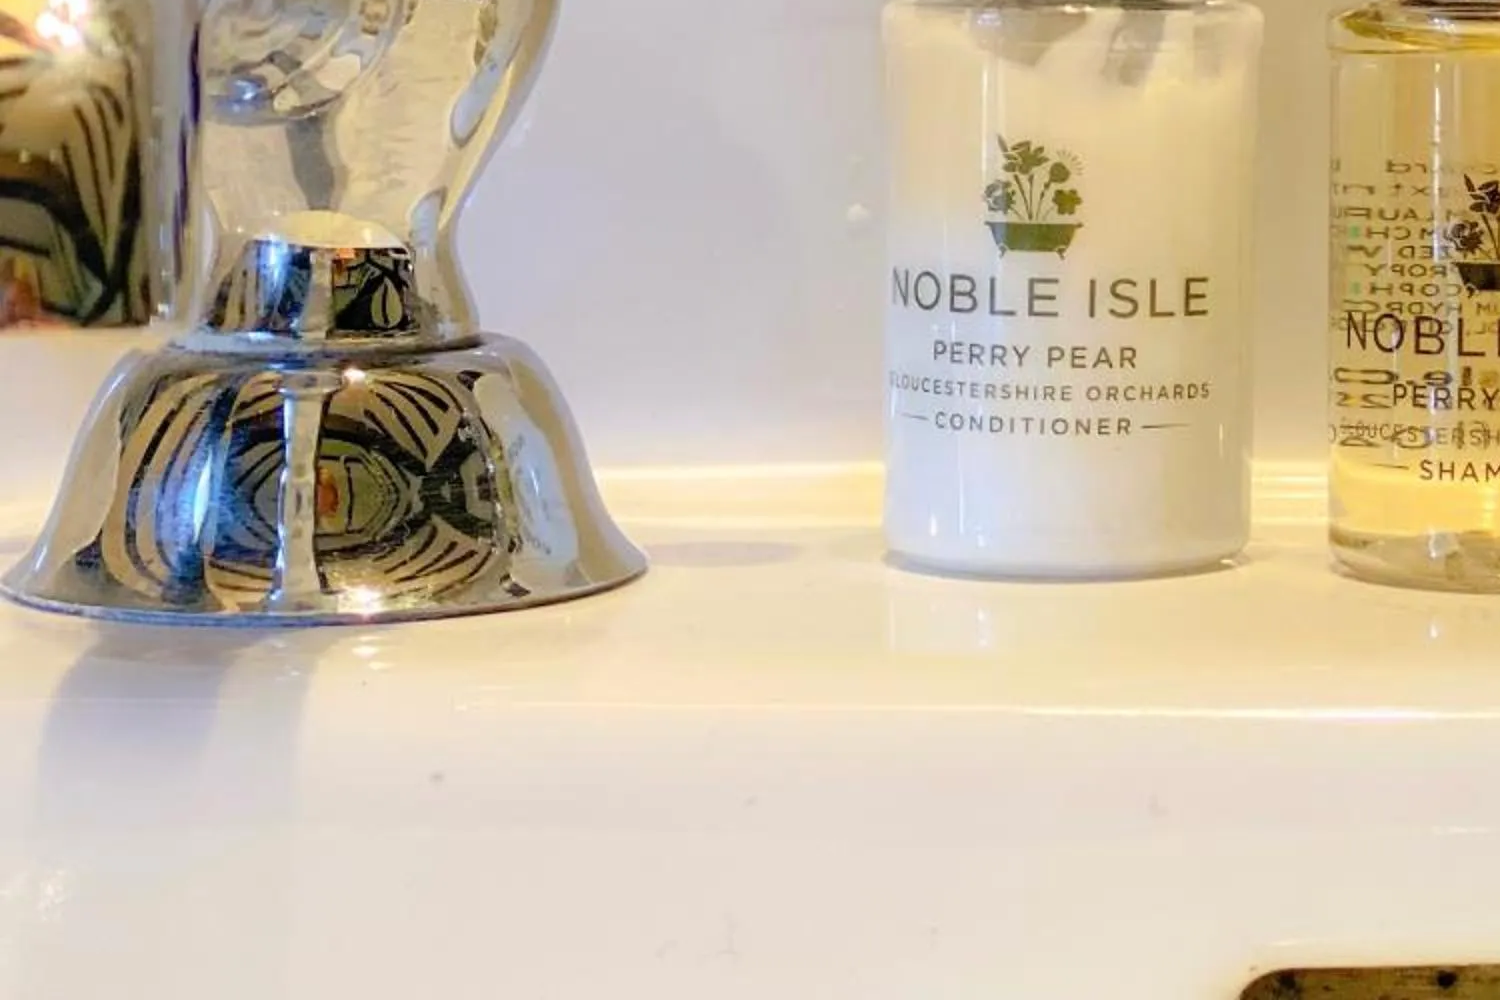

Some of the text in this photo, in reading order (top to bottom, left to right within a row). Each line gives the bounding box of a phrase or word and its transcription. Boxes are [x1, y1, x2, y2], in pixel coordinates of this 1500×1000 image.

[893, 266, 1210, 319] NOBLE ISLE
[932, 340, 1138, 369] PERRY PEAR
[1086, 383, 1211, 401] ORCHARDS
[1393, 383, 1500, 410] PERRY
[935, 411, 1132, 435] CONDITIONER
